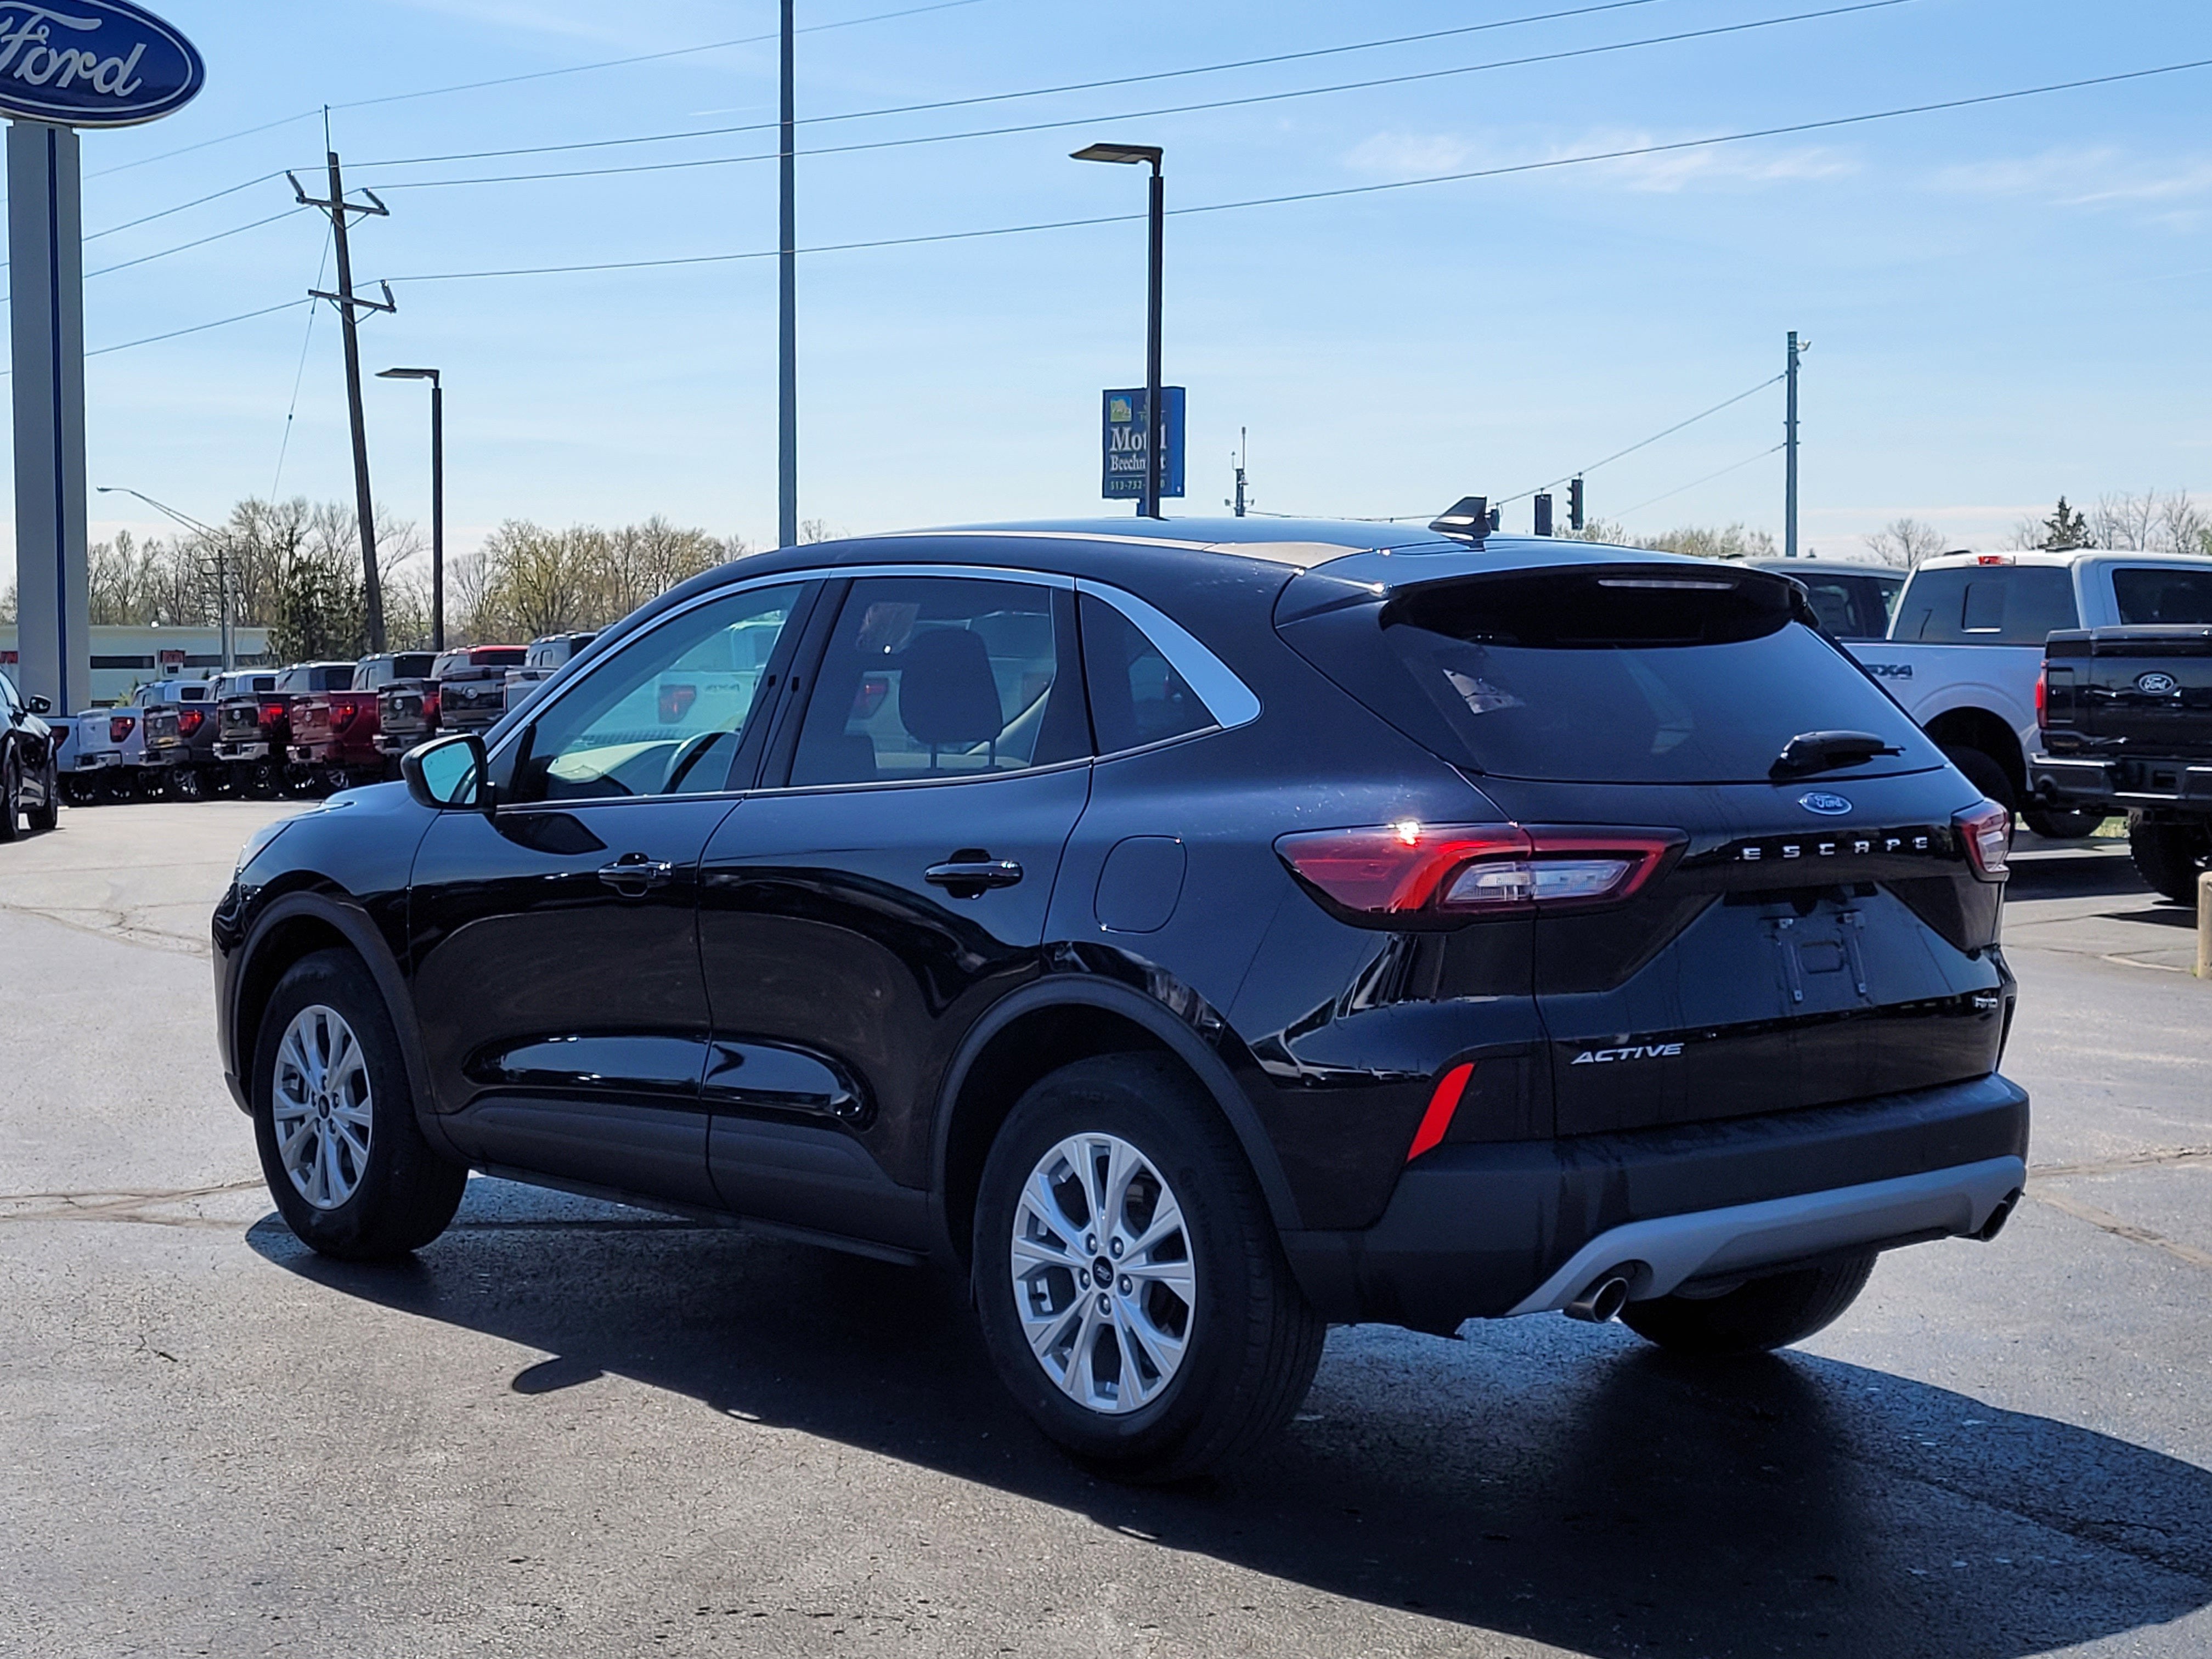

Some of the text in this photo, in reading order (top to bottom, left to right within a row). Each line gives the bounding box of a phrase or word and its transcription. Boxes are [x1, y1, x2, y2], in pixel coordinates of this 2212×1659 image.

[0, 2, 147, 97] Ford
[1742, 836, 1928, 860] ESCAPE
[1570, 1042, 1685, 1064] ACTIVE
